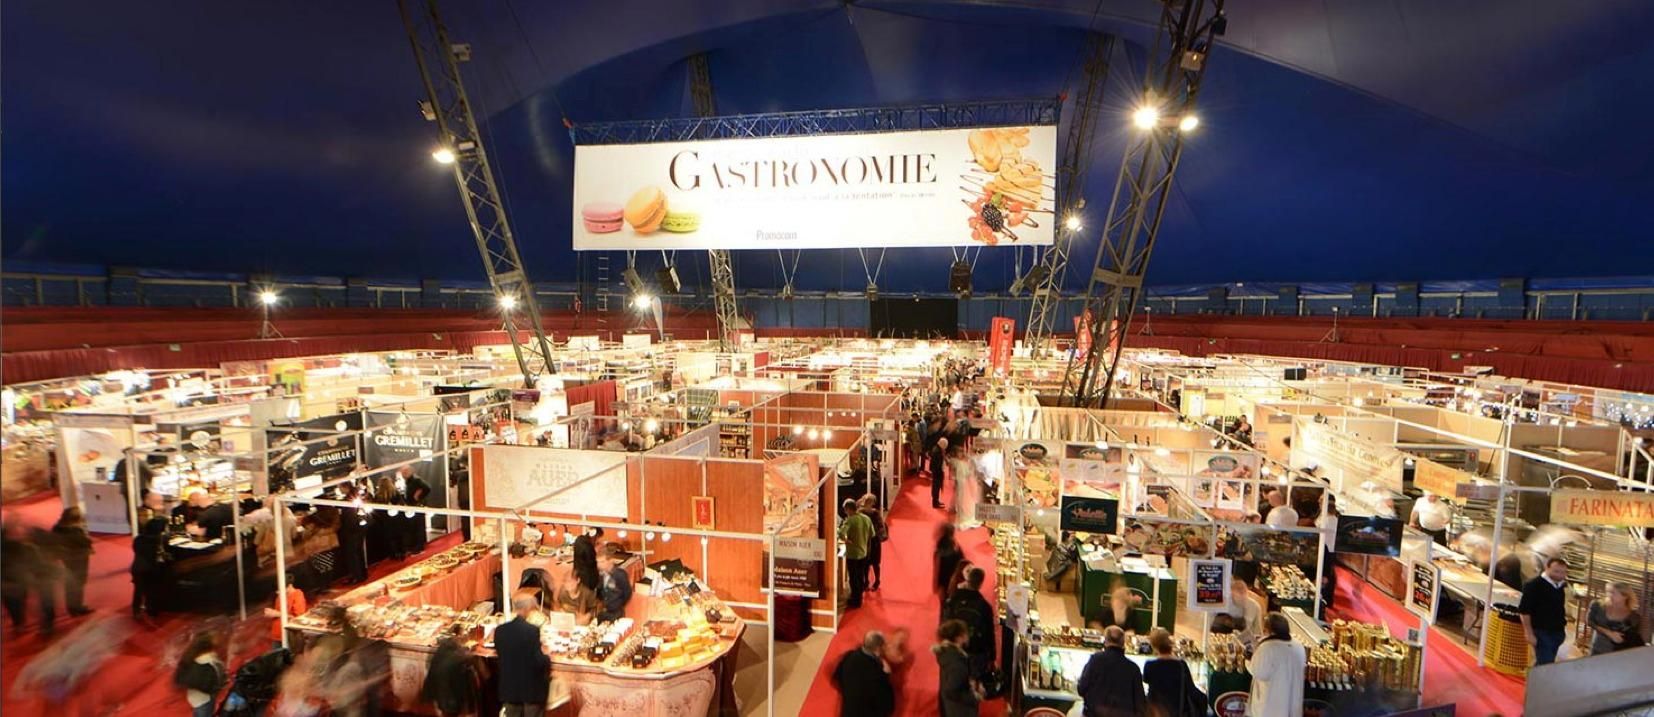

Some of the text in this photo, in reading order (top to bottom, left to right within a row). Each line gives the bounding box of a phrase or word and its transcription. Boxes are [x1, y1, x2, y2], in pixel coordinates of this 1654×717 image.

[669, 150, 937, 191] GASTRONOMIE
[374, 434, 433, 448] GREMILLET
[309, 449, 355, 466] GREMILLET
[1569, 497, 1654, 518] FARINATA
